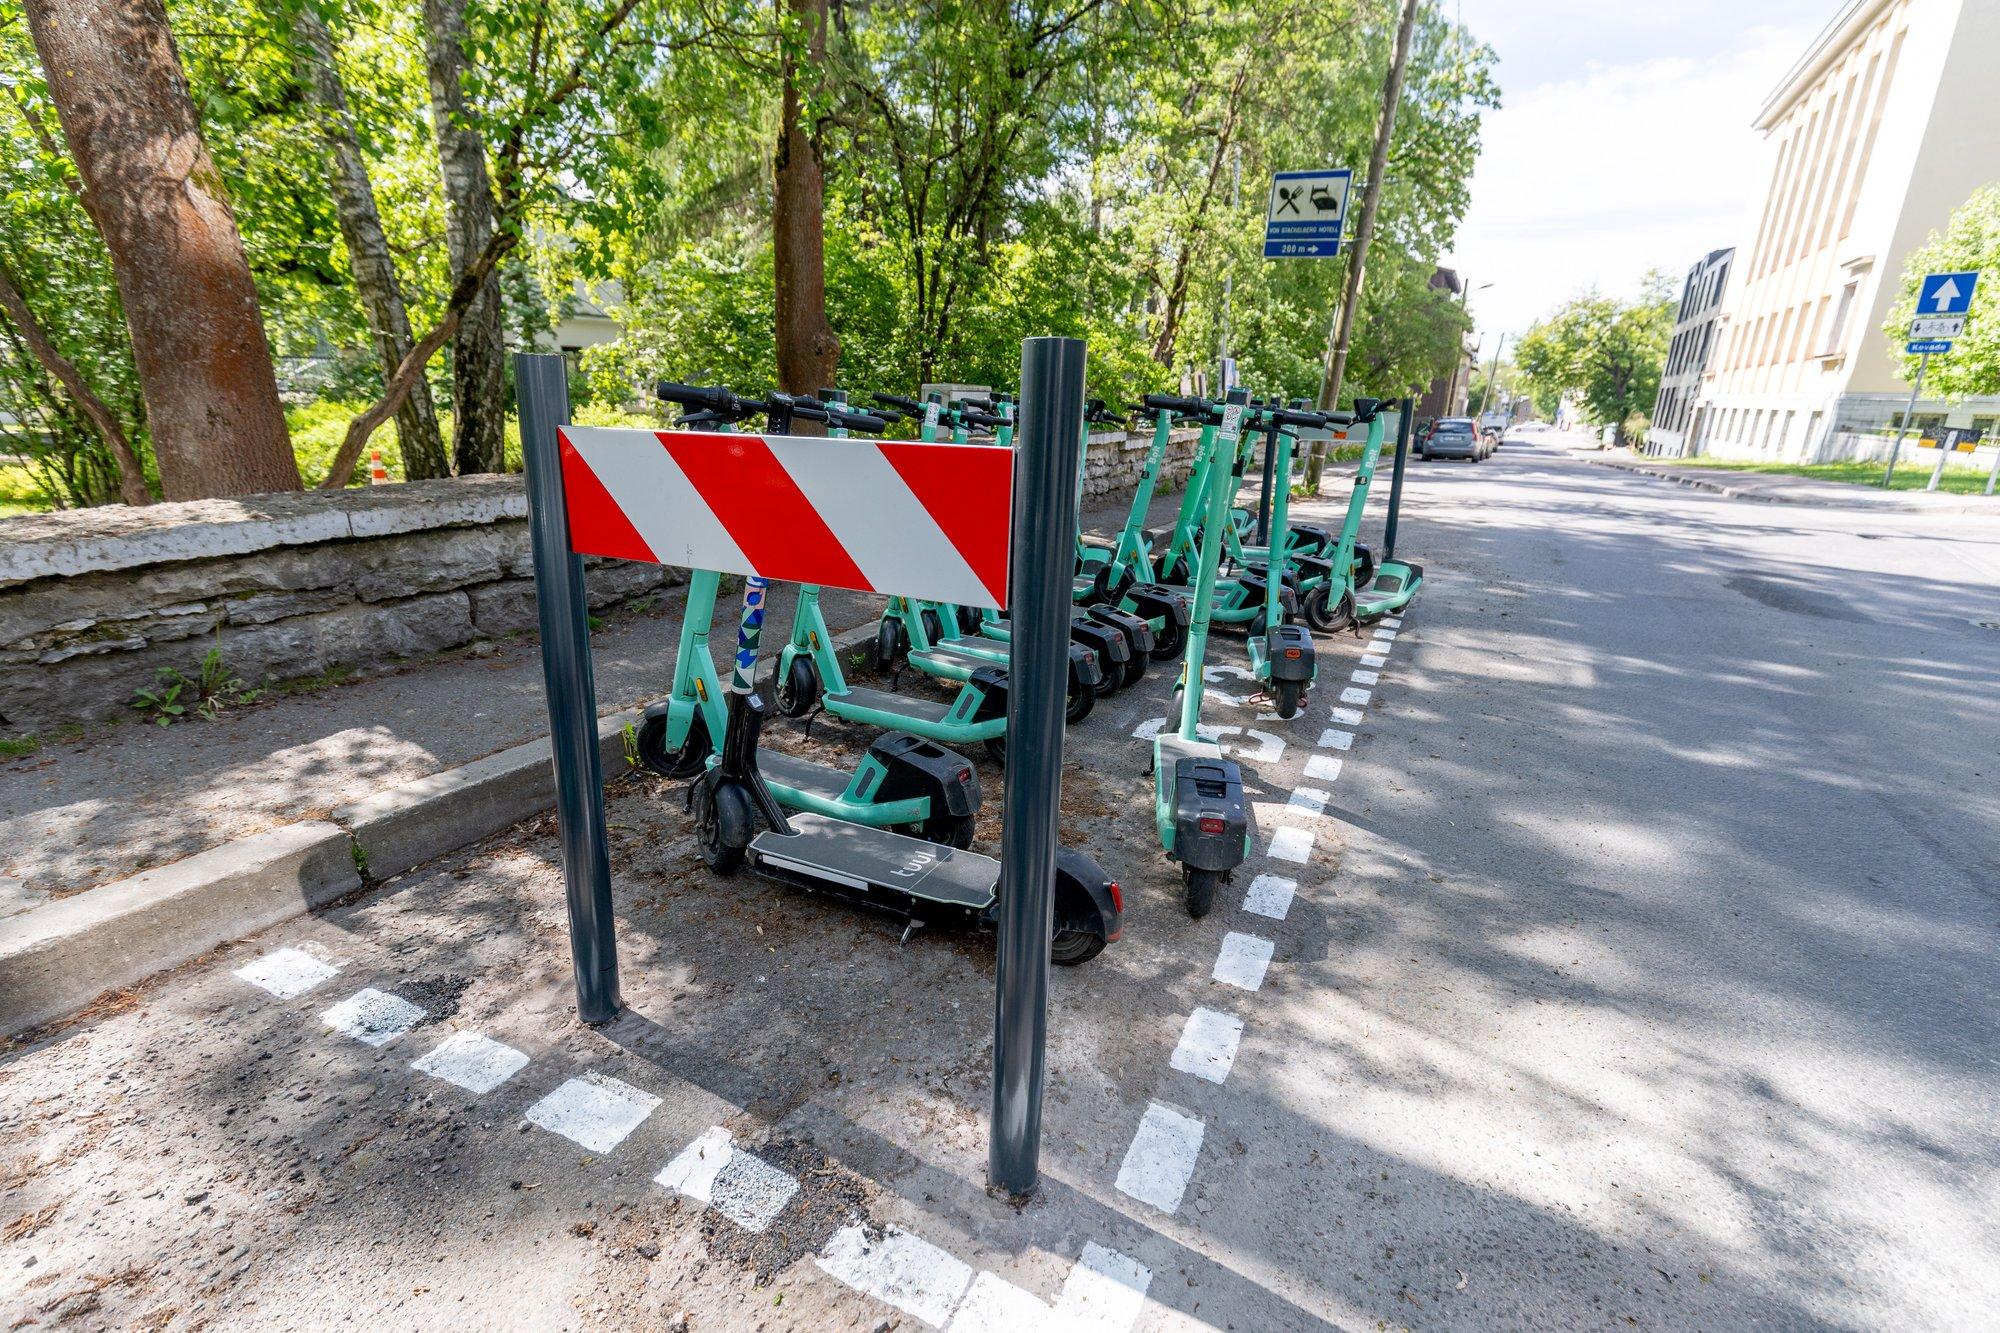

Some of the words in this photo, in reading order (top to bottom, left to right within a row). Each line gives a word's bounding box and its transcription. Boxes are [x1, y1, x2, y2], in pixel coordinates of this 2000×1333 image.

[1269, 226, 1280, 234] VON
[1281, 245, 1296, 253] 200
[1148, 445, 1161, 464] Bolt
[1195, 445, 1206, 462] Bolt
[1365, 449, 1378, 469] Bolt
[890, 851, 937, 877] tuul
